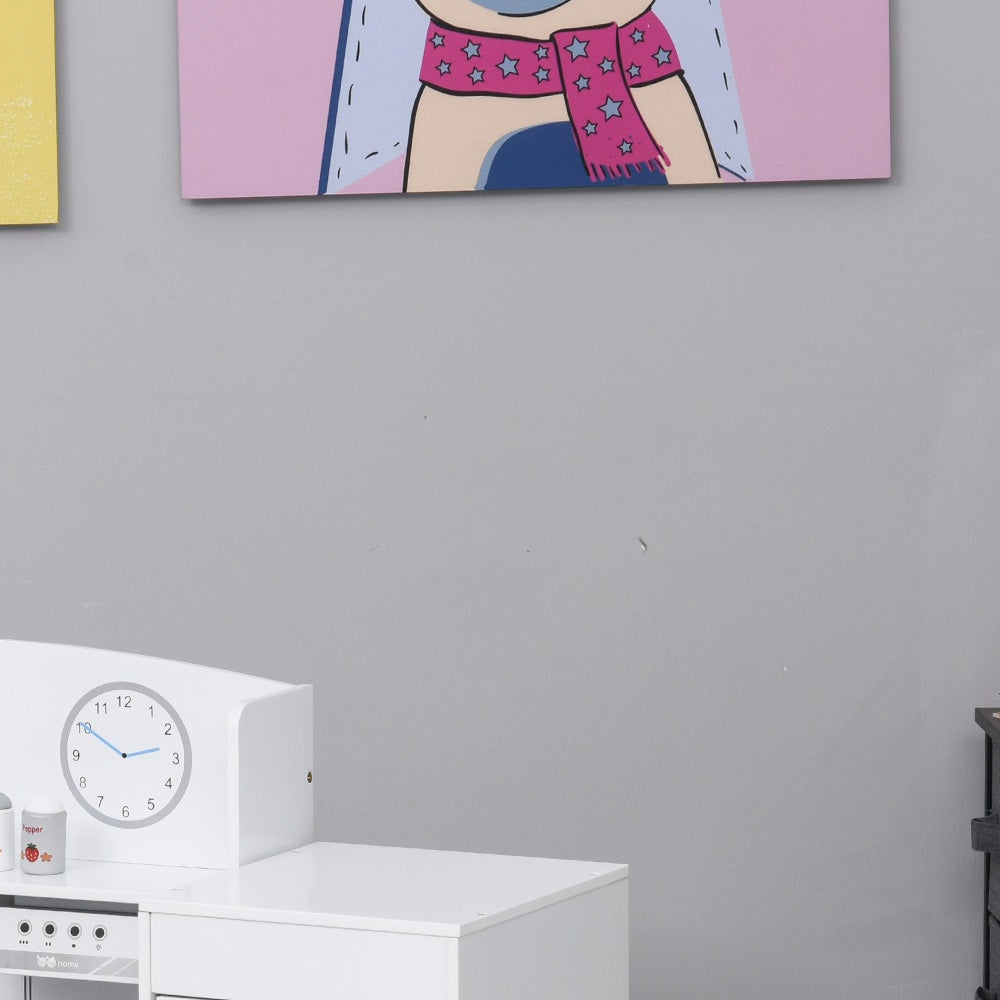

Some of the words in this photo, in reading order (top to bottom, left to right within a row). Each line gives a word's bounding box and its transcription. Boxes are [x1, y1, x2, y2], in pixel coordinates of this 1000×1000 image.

[116, 695, 132, 708] 12
[94, 702, 108, 715] 11
[148, 705, 154, 718] 1
[76, 721, 92, 734] 10
[164, 723, 172, 736] 2
[72, 749, 80, 762] 9
[172, 752, 180, 765] 3
[79, 776, 87, 789] 8
[164, 777, 172, 790] 4
[97, 795, 104, 808] 7
[147, 798, 155, 811] 5
[122, 806, 130, 818] 6
[22, 823, 44, 835] Pepper
